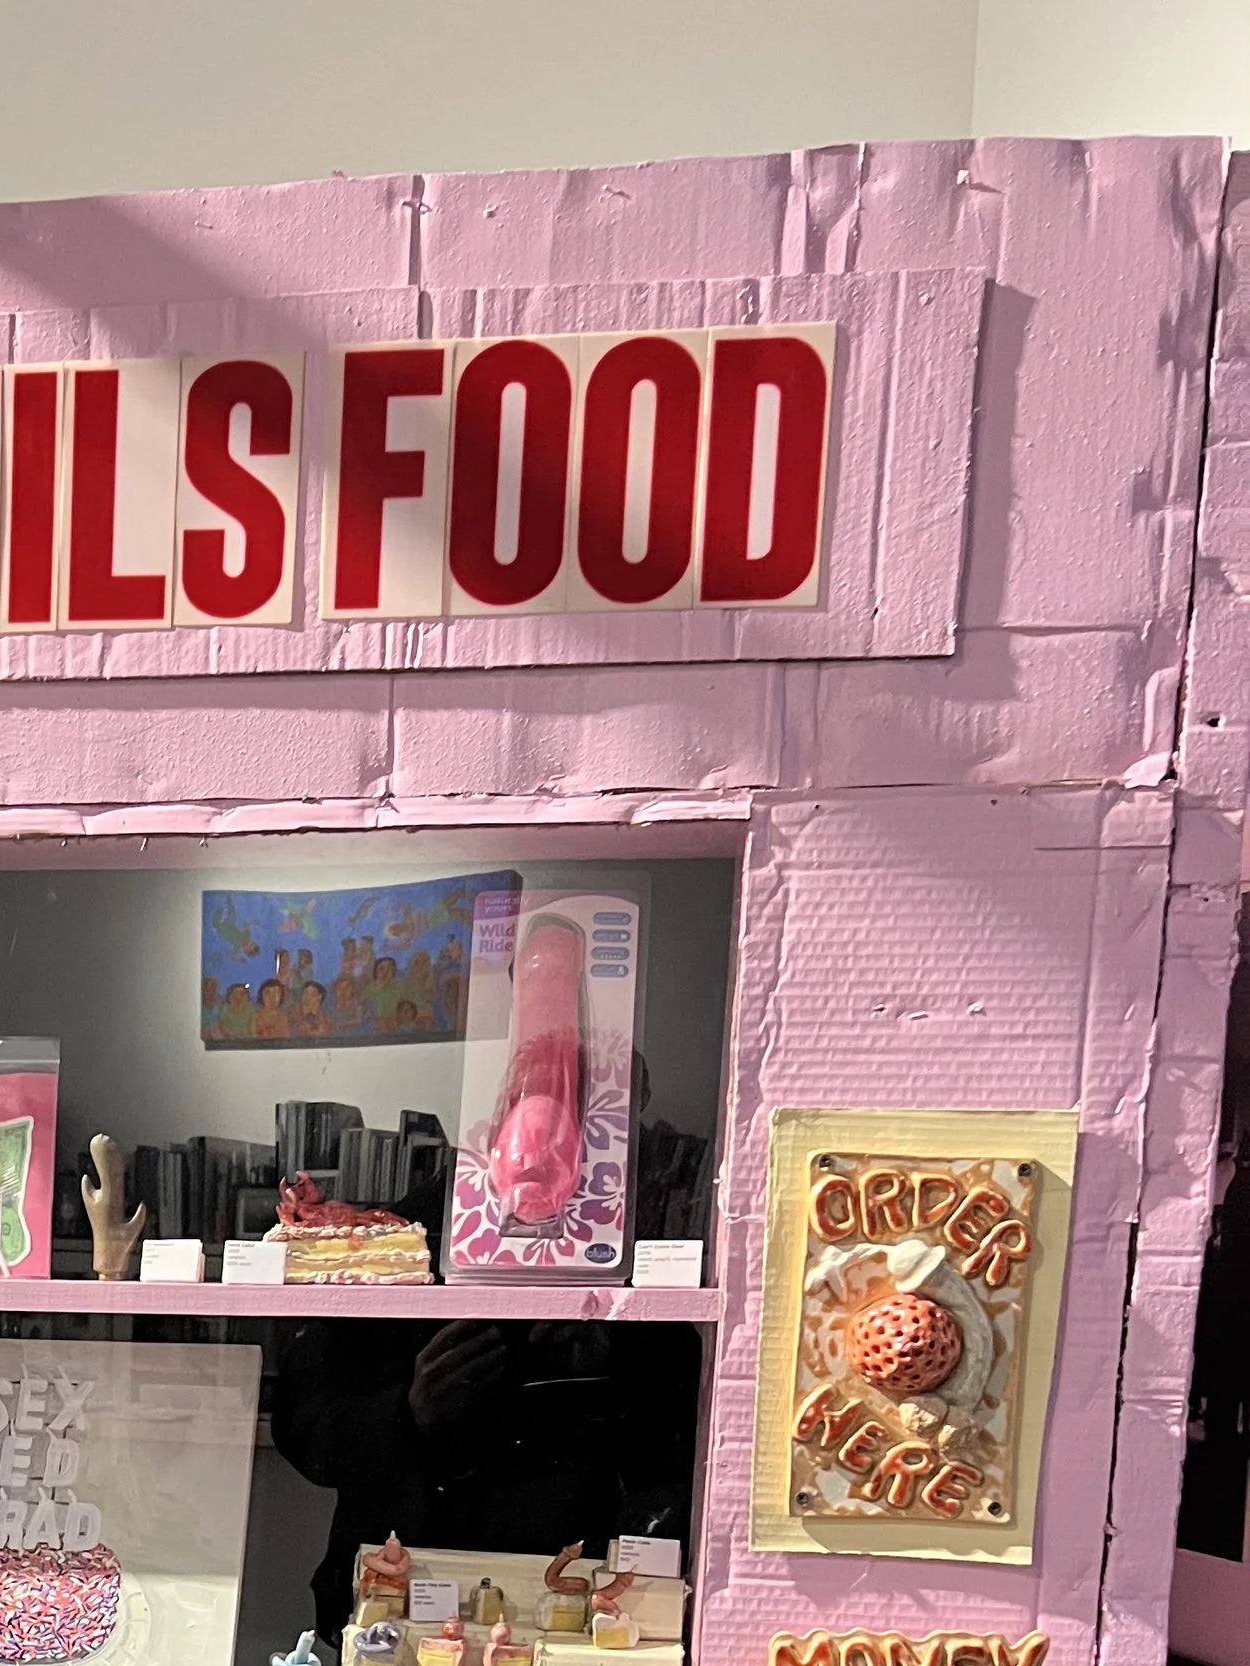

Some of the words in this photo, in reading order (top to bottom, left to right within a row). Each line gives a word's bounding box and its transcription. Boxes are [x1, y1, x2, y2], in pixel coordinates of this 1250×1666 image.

[334, 334, 828, 611] FOOD
[479, 924, 516, 938] Wild
[479, 939, 514, 953] Ride
[586, 1245, 616, 1259] blush
[810, 1169, 1032, 1286] ORDER
[793, 1384, 984, 1517] HERE
